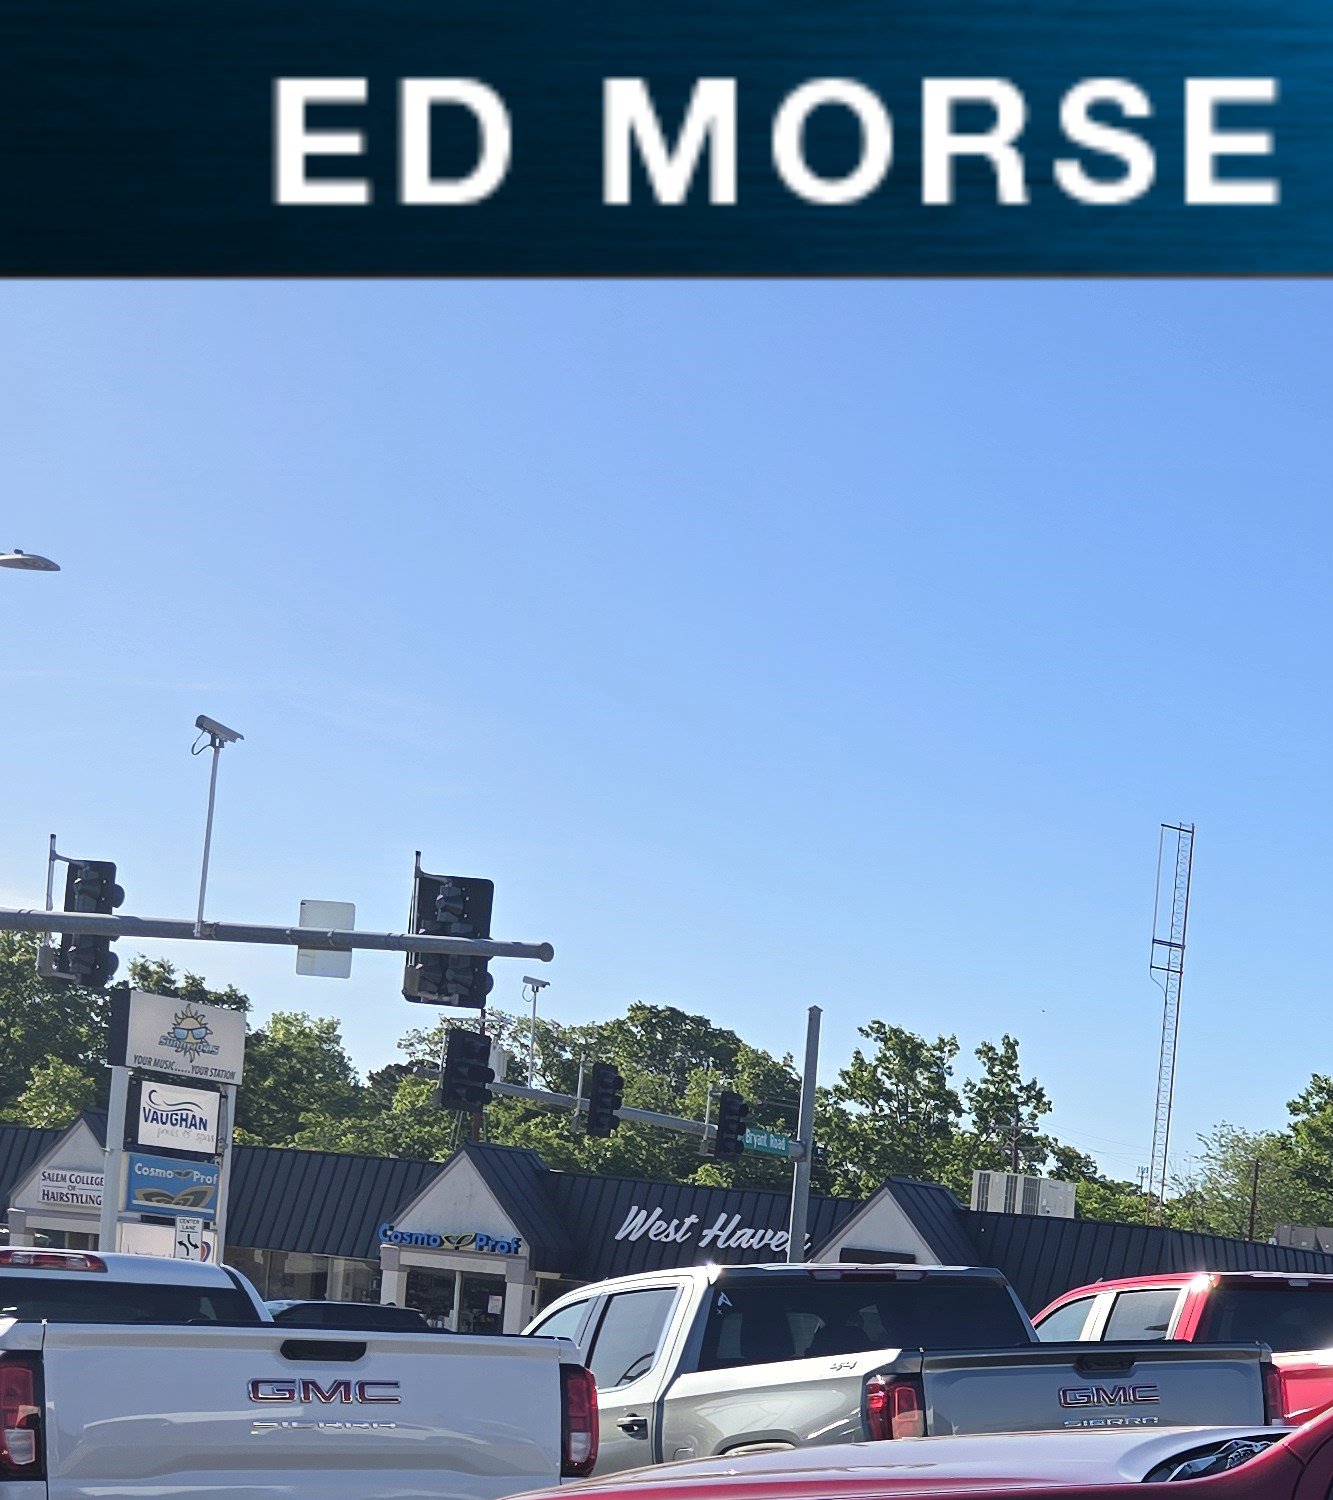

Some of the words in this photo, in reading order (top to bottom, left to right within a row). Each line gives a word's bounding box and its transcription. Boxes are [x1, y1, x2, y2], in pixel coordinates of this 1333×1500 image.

[133, 1054, 152, 1066] YOUR
[209, 1067, 236, 1080] STATION
[143, 1107, 208, 1131] VAUGHAN
[745, 1129, 767, 1148] Bryant
[770, 1133, 786, 1150] Road
[41, 1171, 67, 1183] SALEM
[69, 1174, 104, 1186] COLLEGE
[134, 1162, 174, 1179] Cosmo
[193, 1170, 218, 1184] Prof
[42, 1189, 102, 1205] HAIRSTYLING
[614, 1206, 699, 1242] West
[378, 1222, 442, 1247] Cosmo
[475, 1232, 522, 1254] Prof
[248, 1378, 402, 1404] GMC
[1059, 1384, 1160, 1408] GMC
